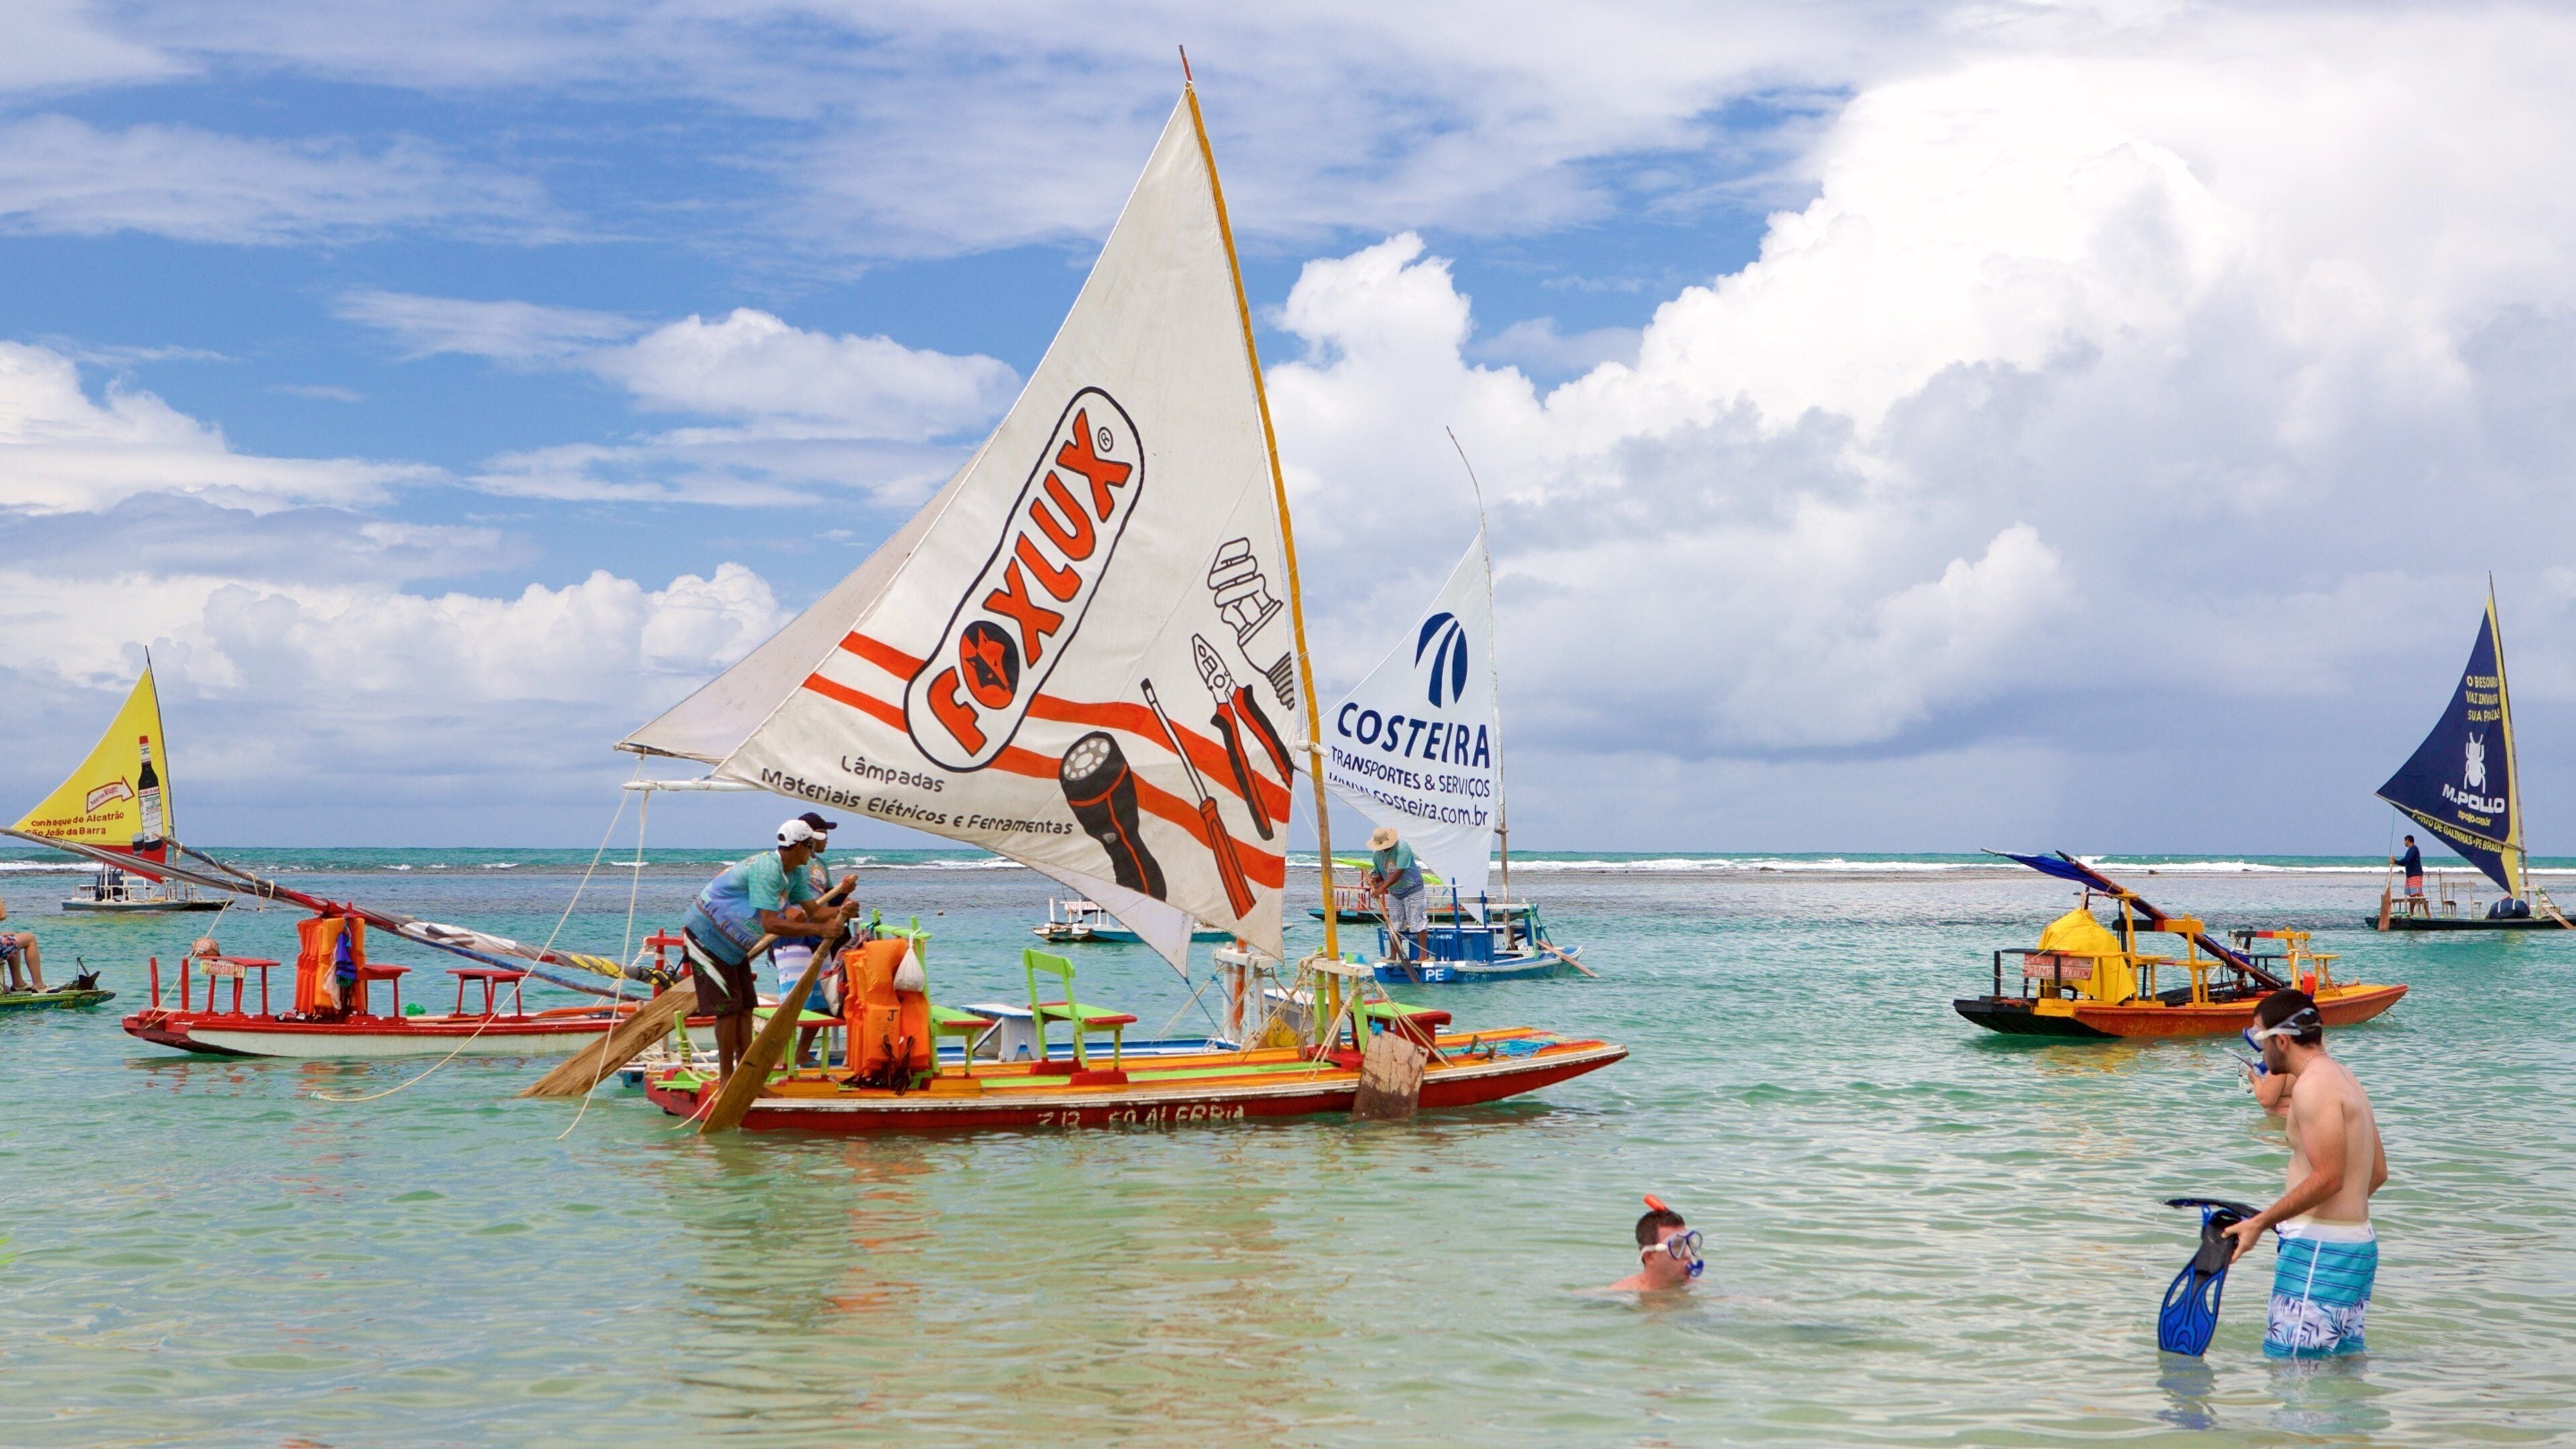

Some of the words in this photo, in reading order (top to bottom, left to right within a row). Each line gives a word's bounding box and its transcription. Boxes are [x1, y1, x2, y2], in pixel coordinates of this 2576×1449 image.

[927, 407, 1132, 756] FOXLUX
[2465, 690, 2477, 704] VAI
[2467, 676, 2473, 687] O
[2474, 676, 2498, 689] BESOURO
[2467, 710, 2482, 722] SUA
[1337, 702, 1490, 768] COSTEIRA
[841, 755, 945, 792] Lâmpadas
[1332, 746, 1421, 790] TRANSPORTES
[1424, 773, 1435, 791] &
[1438, 775, 1490, 799] SERVIÇOS
[761, 768, 861, 807] Materiais
[867, 797, 947, 824] Elétricos
[953, 815, 964, 827] e
[967, 814, 1073, 835] Ferramentas
[2442, 784, 2505, 813] M.POLLO
[31, 818, 72, 826] Conhaque
[86, 811, 124, 822] Alcatrão
[45, 828, 64, 837] João
[2434, 821, 2443, 833] DE
[2482, 840, 2502, 853] BRASIL
[1426, 969, 1445, 981] PE
